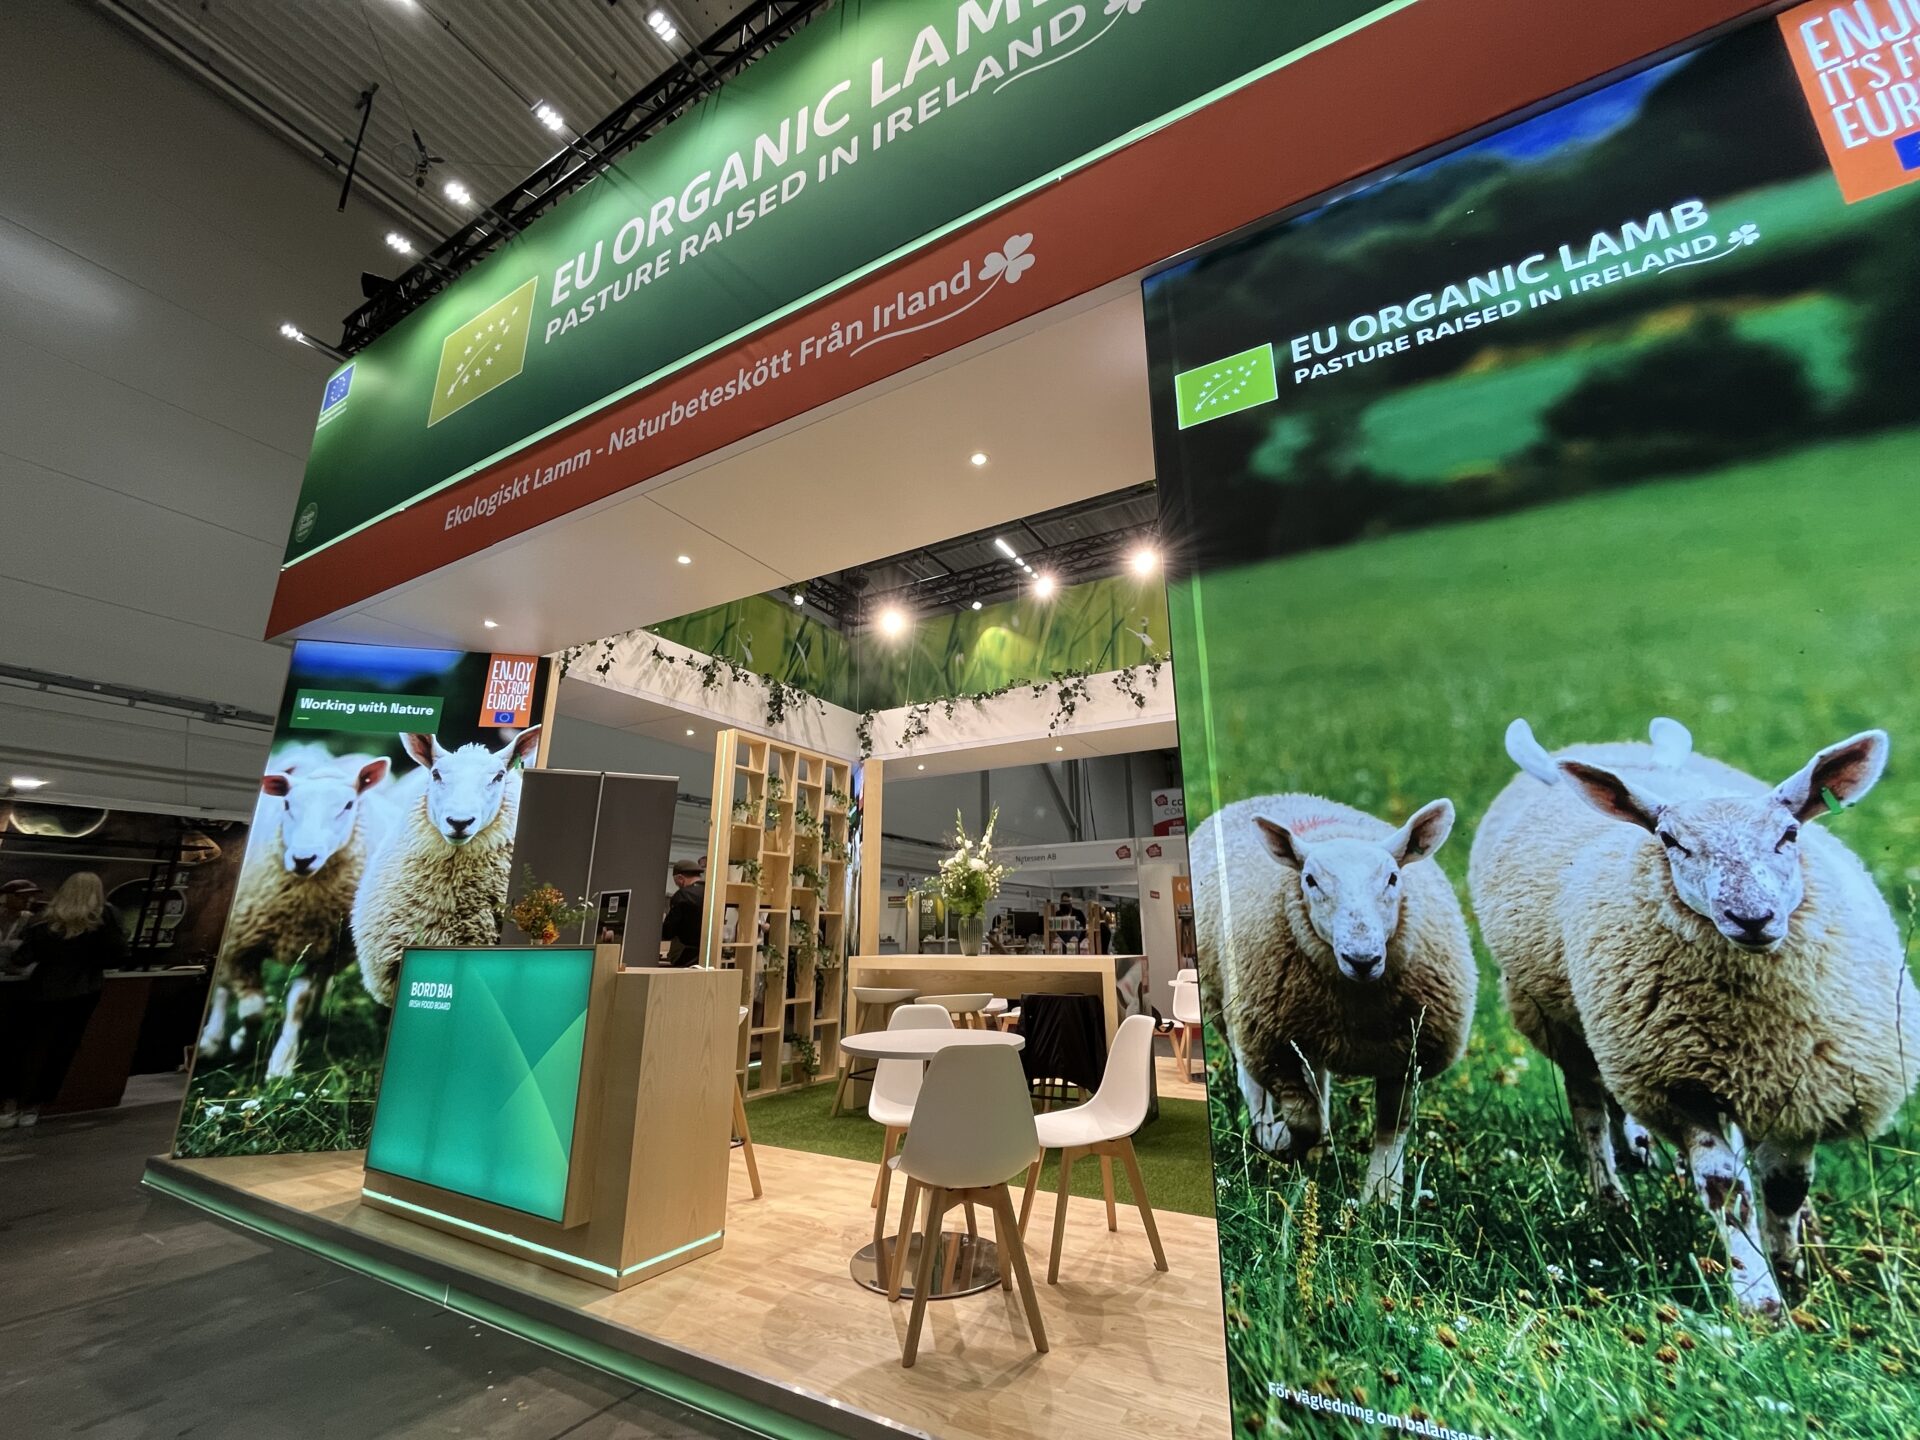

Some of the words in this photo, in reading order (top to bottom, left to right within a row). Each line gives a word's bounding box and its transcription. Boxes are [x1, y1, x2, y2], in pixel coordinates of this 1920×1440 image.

[1819, 53, 1891, 105] IT'S
[1891, 35, 1920, 79] F
[545, 250, 671, 344] PASTURE
[680, 170, 806, 265] RAISED
[818, 137, 859, 184] IN
[873, 4, 1087, 150] IRELAND
[550, 241, 603, 307] EU
[613, 80, 850, 265] ORGANIC
[871, 0, 1052, 108] LAM
[1291, 326, 1337, 363] EU
[1348, 254, 1549, 342] ORGANIC
[1559, 201, 1709, 272] LAMB
[1295, 335, 1410, 383] PASTURE
[1417, 300, 1521, 345] RAISED
[1529, 285, 1561, 308] IN
[1570, 235, 1718, 294] IRELAND
[444, 474, 530, 531] Ekologiskt
[533, 449, 591, 489] Lamm
[609, 349, 791, 455] Naturbeteskött
[800, 320, 863, 366] Från
[873, 260, 970, 333] Irland
[489, 680, 505, 693] IT'S
[508, 681, 531, 694] FROM
[491, 661, 534, 682] ENJOY
[300, 697, 355, 715] Working
[358, 701, 390, 714] with
[390, 703, 434, 716] Nature
[486, 694, 529, 711] EUROPE
[410, 981, 437, 997] BORD
[437, 983, 453, 999] BIA
[421, 1000, 434, 1008] FOOD
[434, 1001, 451, 1010] BOARD
[1268, 1381, 1293, 1400] För
[1294, 1389, 1374, 1424] vägledning
[1377, 1411, 1402, 1428] om
